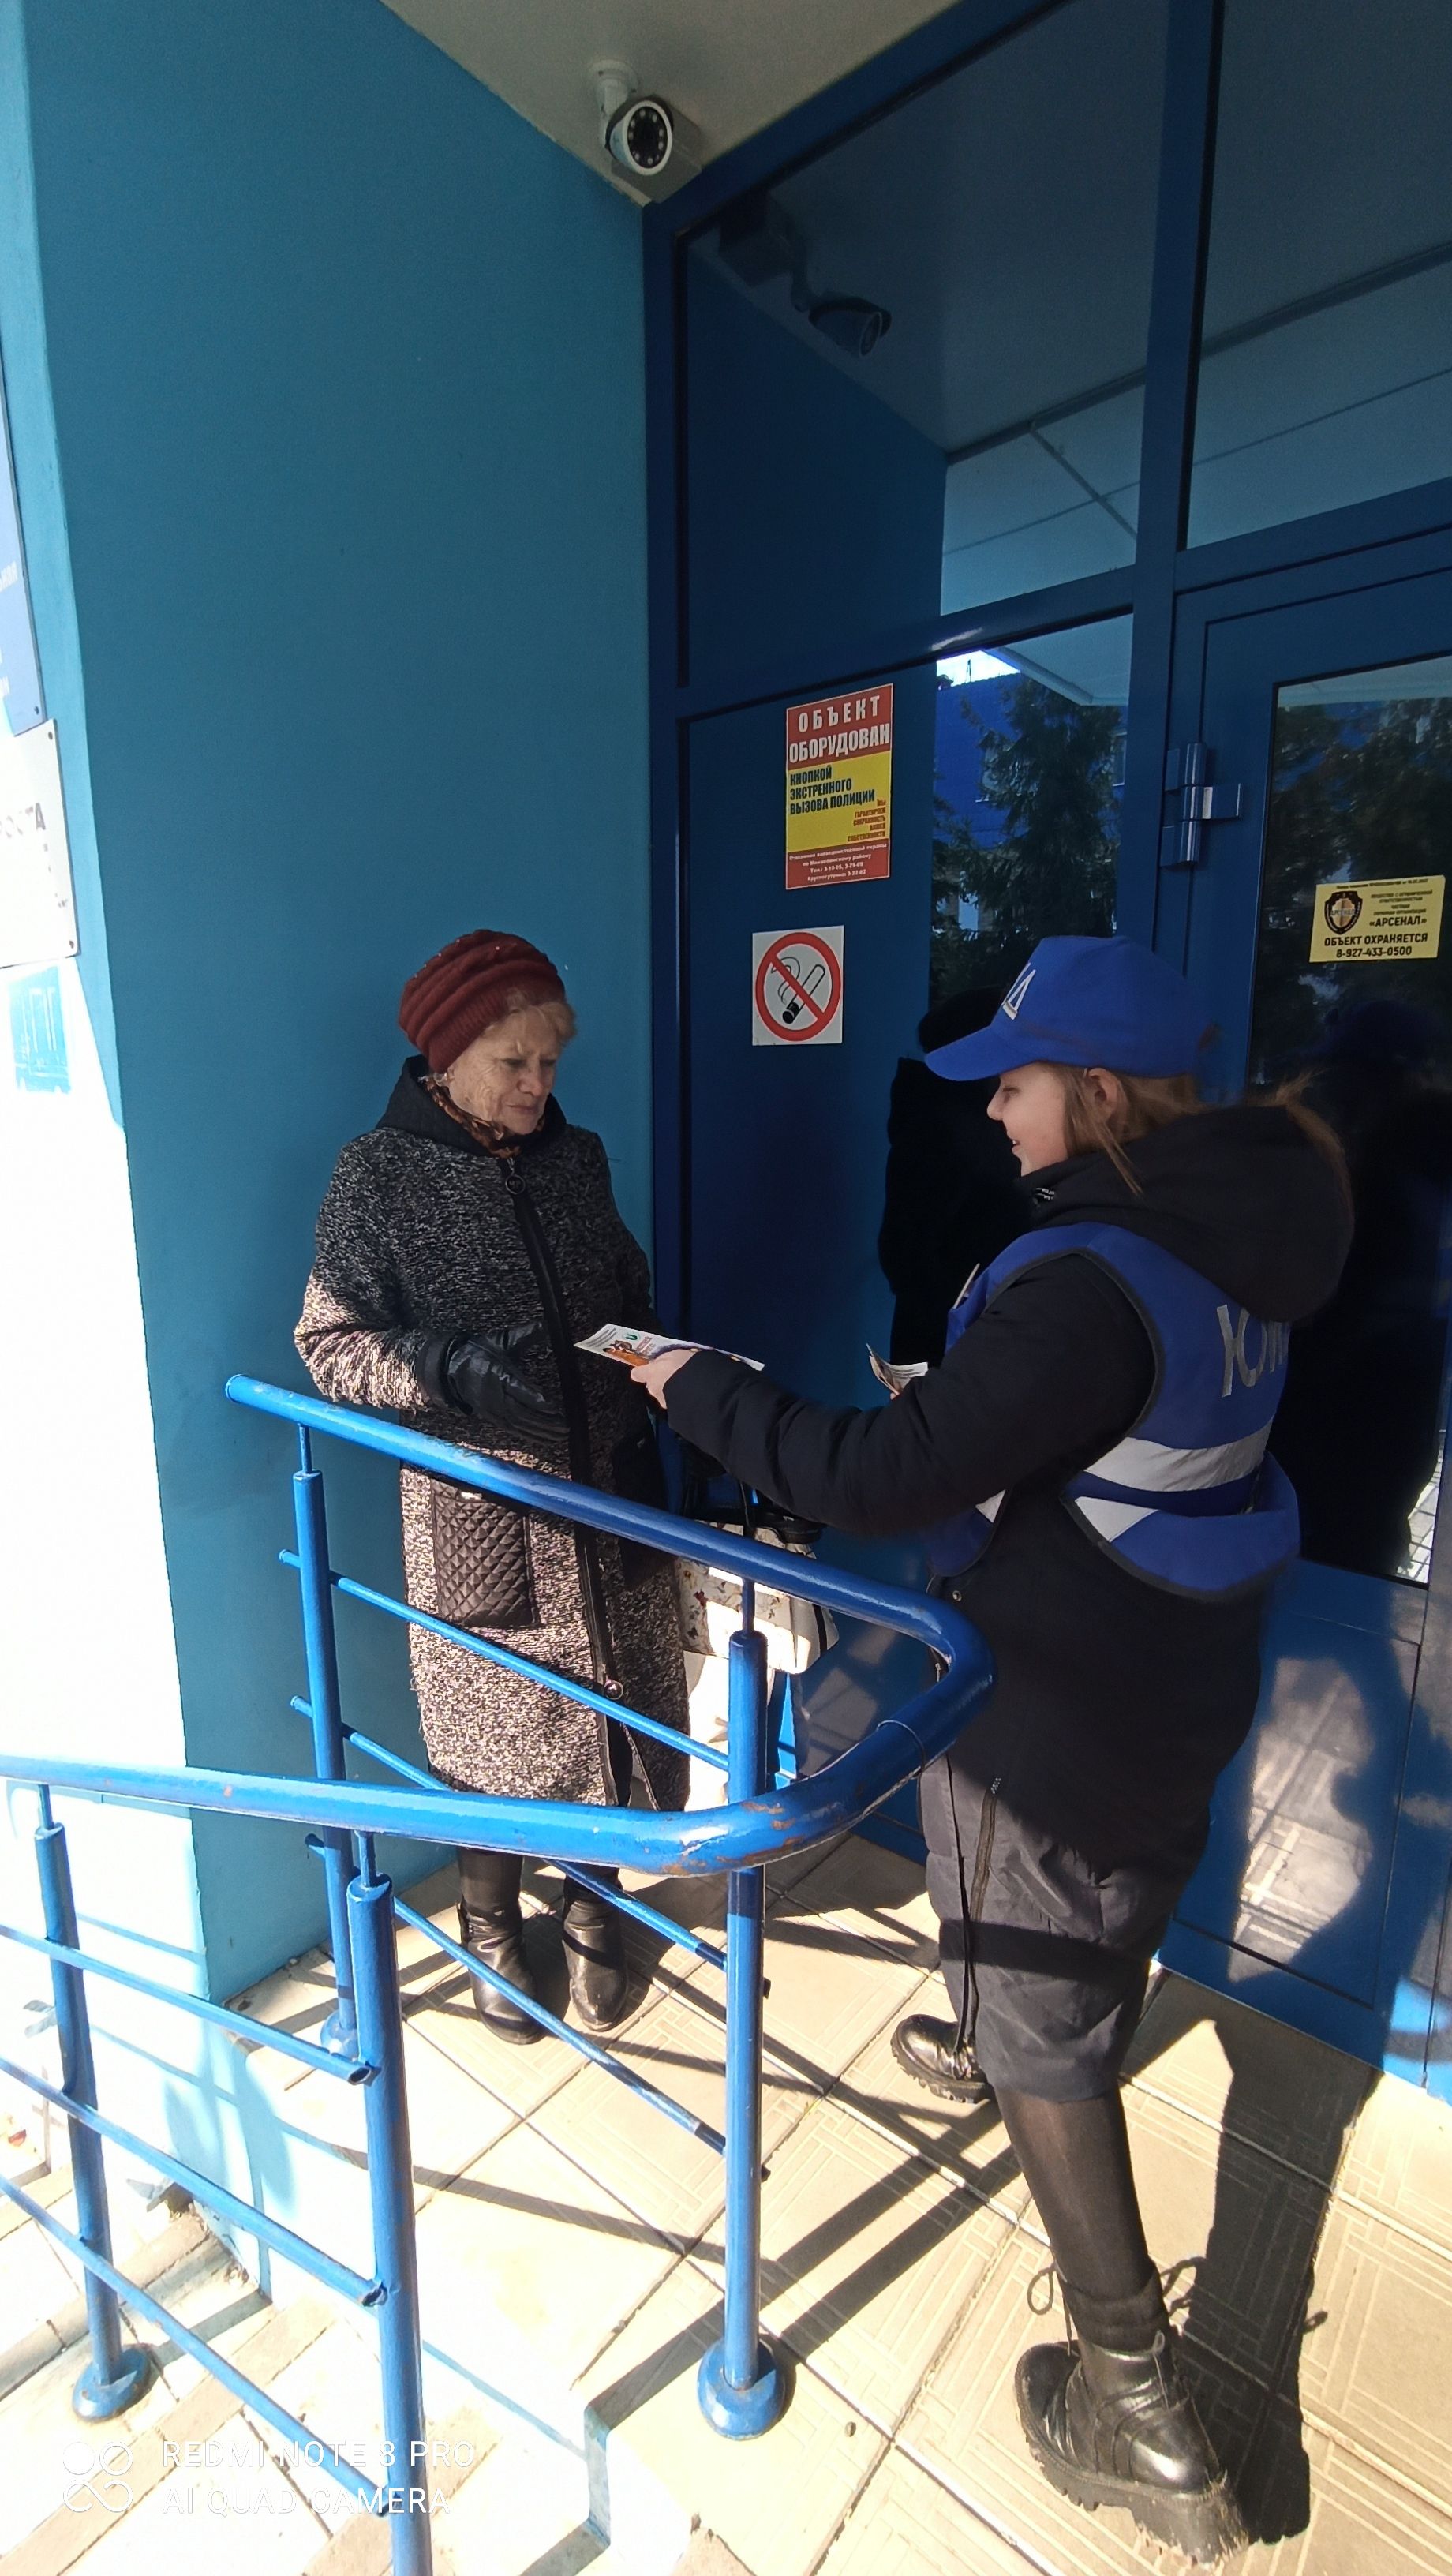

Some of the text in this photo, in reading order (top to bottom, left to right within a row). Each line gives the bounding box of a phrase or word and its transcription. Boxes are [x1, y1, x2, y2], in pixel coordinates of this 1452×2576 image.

[799, 695, 880, 733] ОБЪЕКТ
[789, 722, 890, 764] ОБОРУДОВАН
[790, 764, 833, 786] КНОПКОЙ
[790, 777, 852, 800] ЭКСТРЕННОГО
[790, 788, 875, 815] ВЫЗОВА ПОЛИЦИИ
[1369, 915, 1427, 927] «АРСЕНАЛ»
[1324, 933, 1428, 946] ОБЪЕКТ ОХРАНЯЕТСЯ
[1336, 946, 1413, 958] 8-927-433-0500
